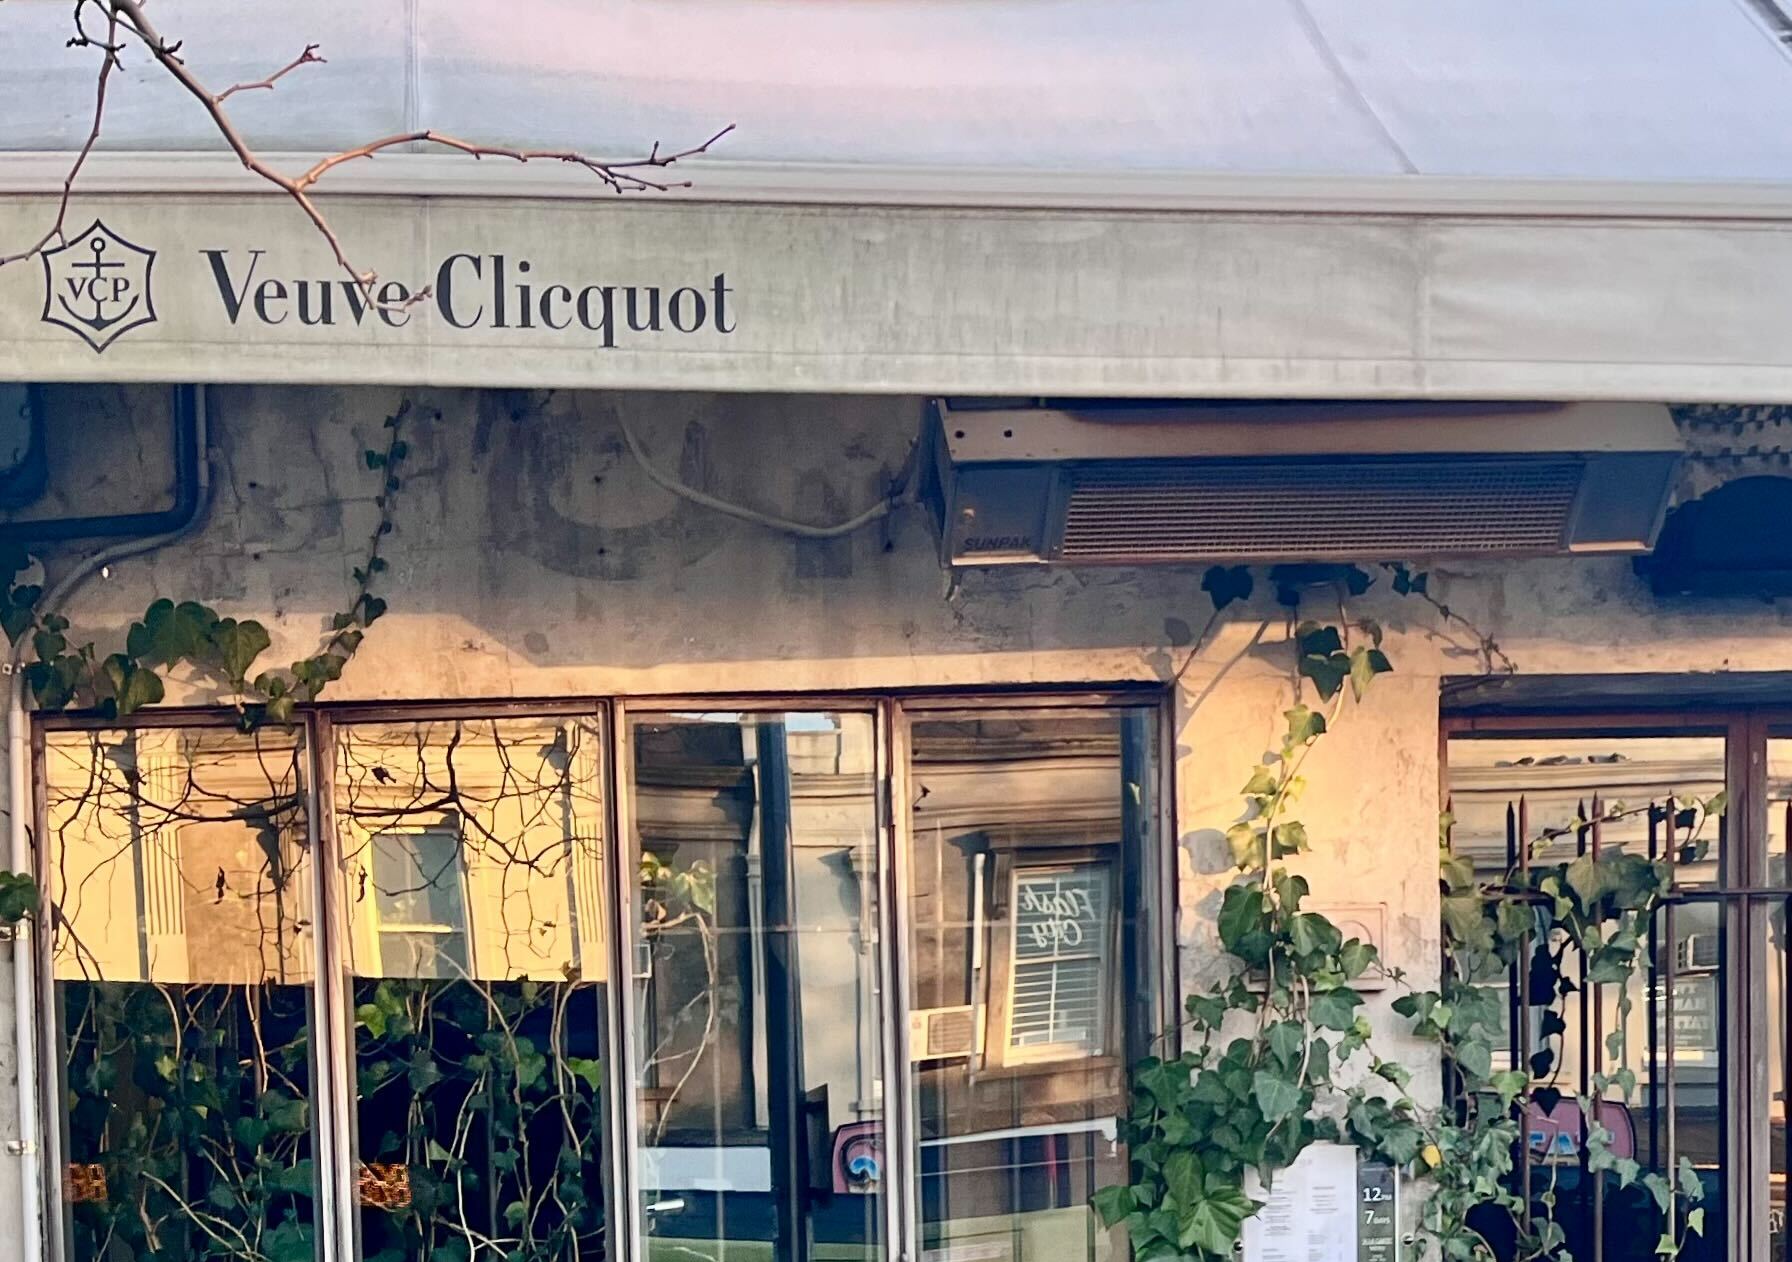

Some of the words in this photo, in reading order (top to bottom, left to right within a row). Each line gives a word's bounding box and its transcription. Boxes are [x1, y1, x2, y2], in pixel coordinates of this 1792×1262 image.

[199, 249, 411, 327] Veuve
[435, 253, 737, 349] Clicquot
[963, 536, 1032, 550] SUNPAK
